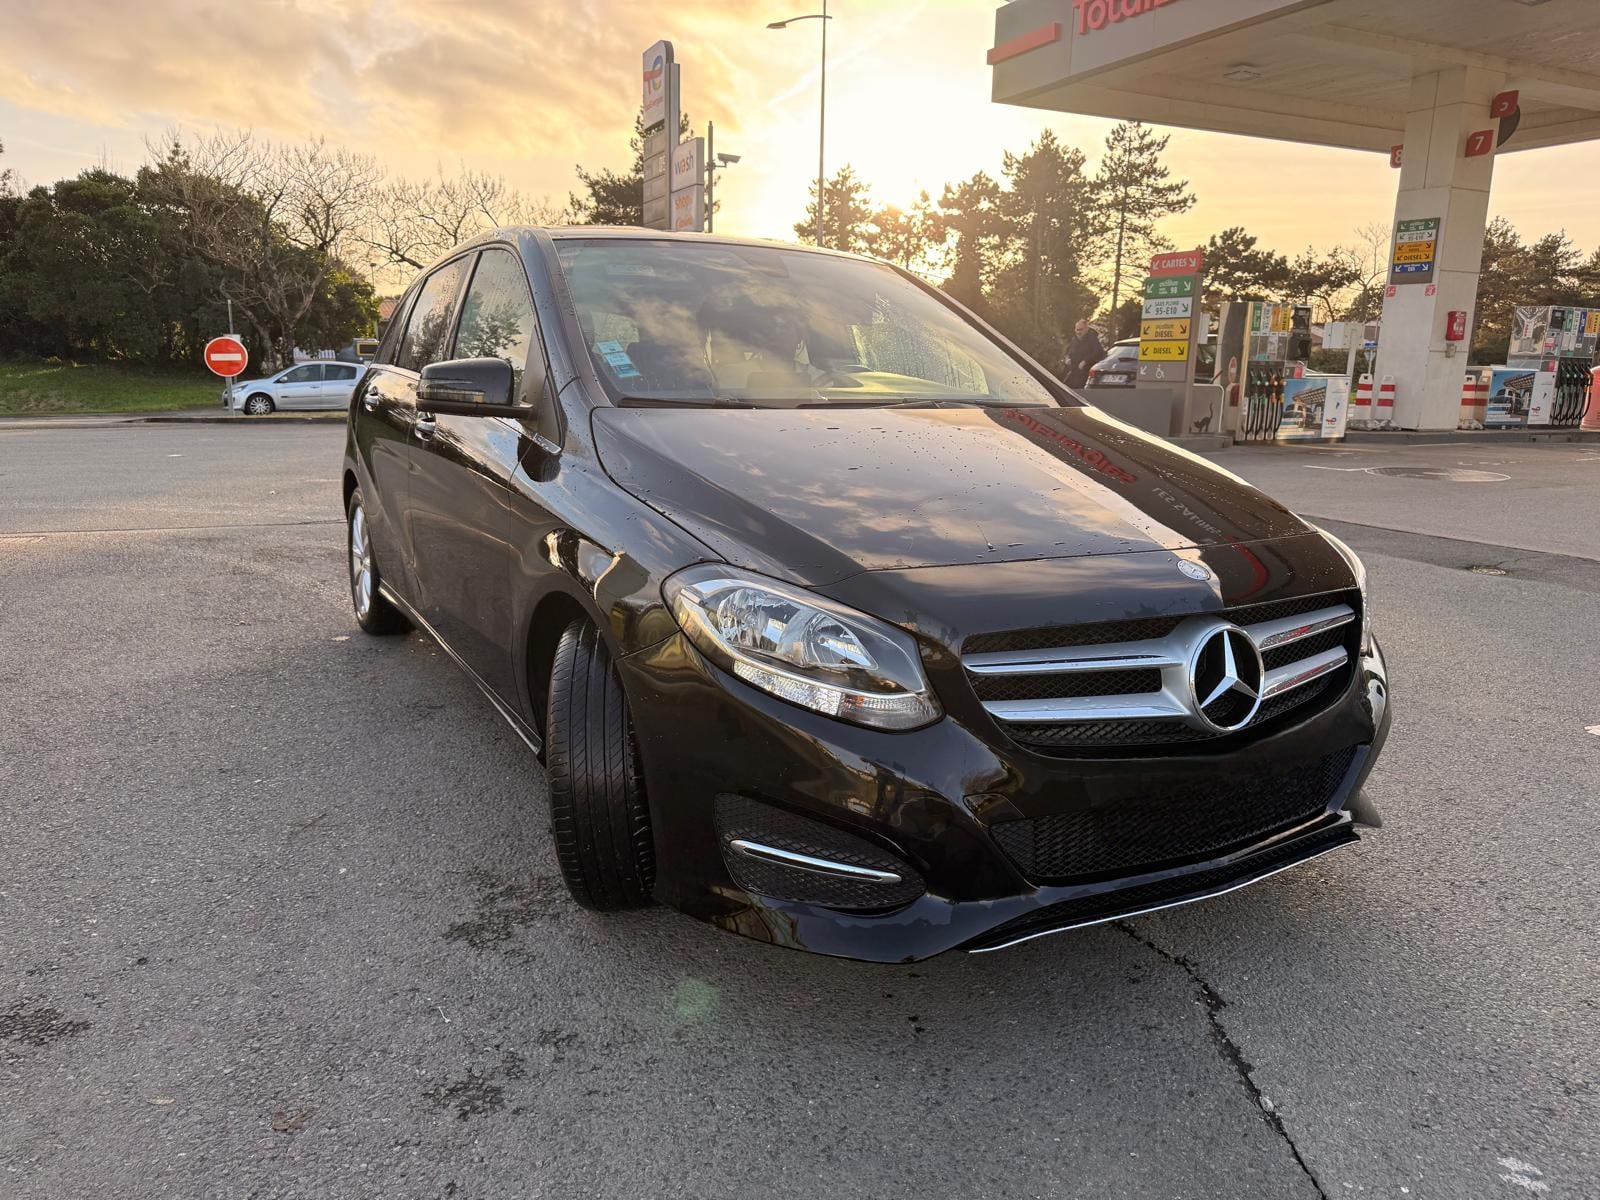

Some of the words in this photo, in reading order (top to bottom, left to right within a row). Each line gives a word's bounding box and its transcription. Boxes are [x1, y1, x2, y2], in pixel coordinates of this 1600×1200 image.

[1475, 136, 1485, 152] 7
[674, 152, 694, 176] wash
[1161, 258, 1187, 269] CARTES
[1154, 306, 1178, 316] 95-E10
[1153, 347, 1172, 355] DIESEL
